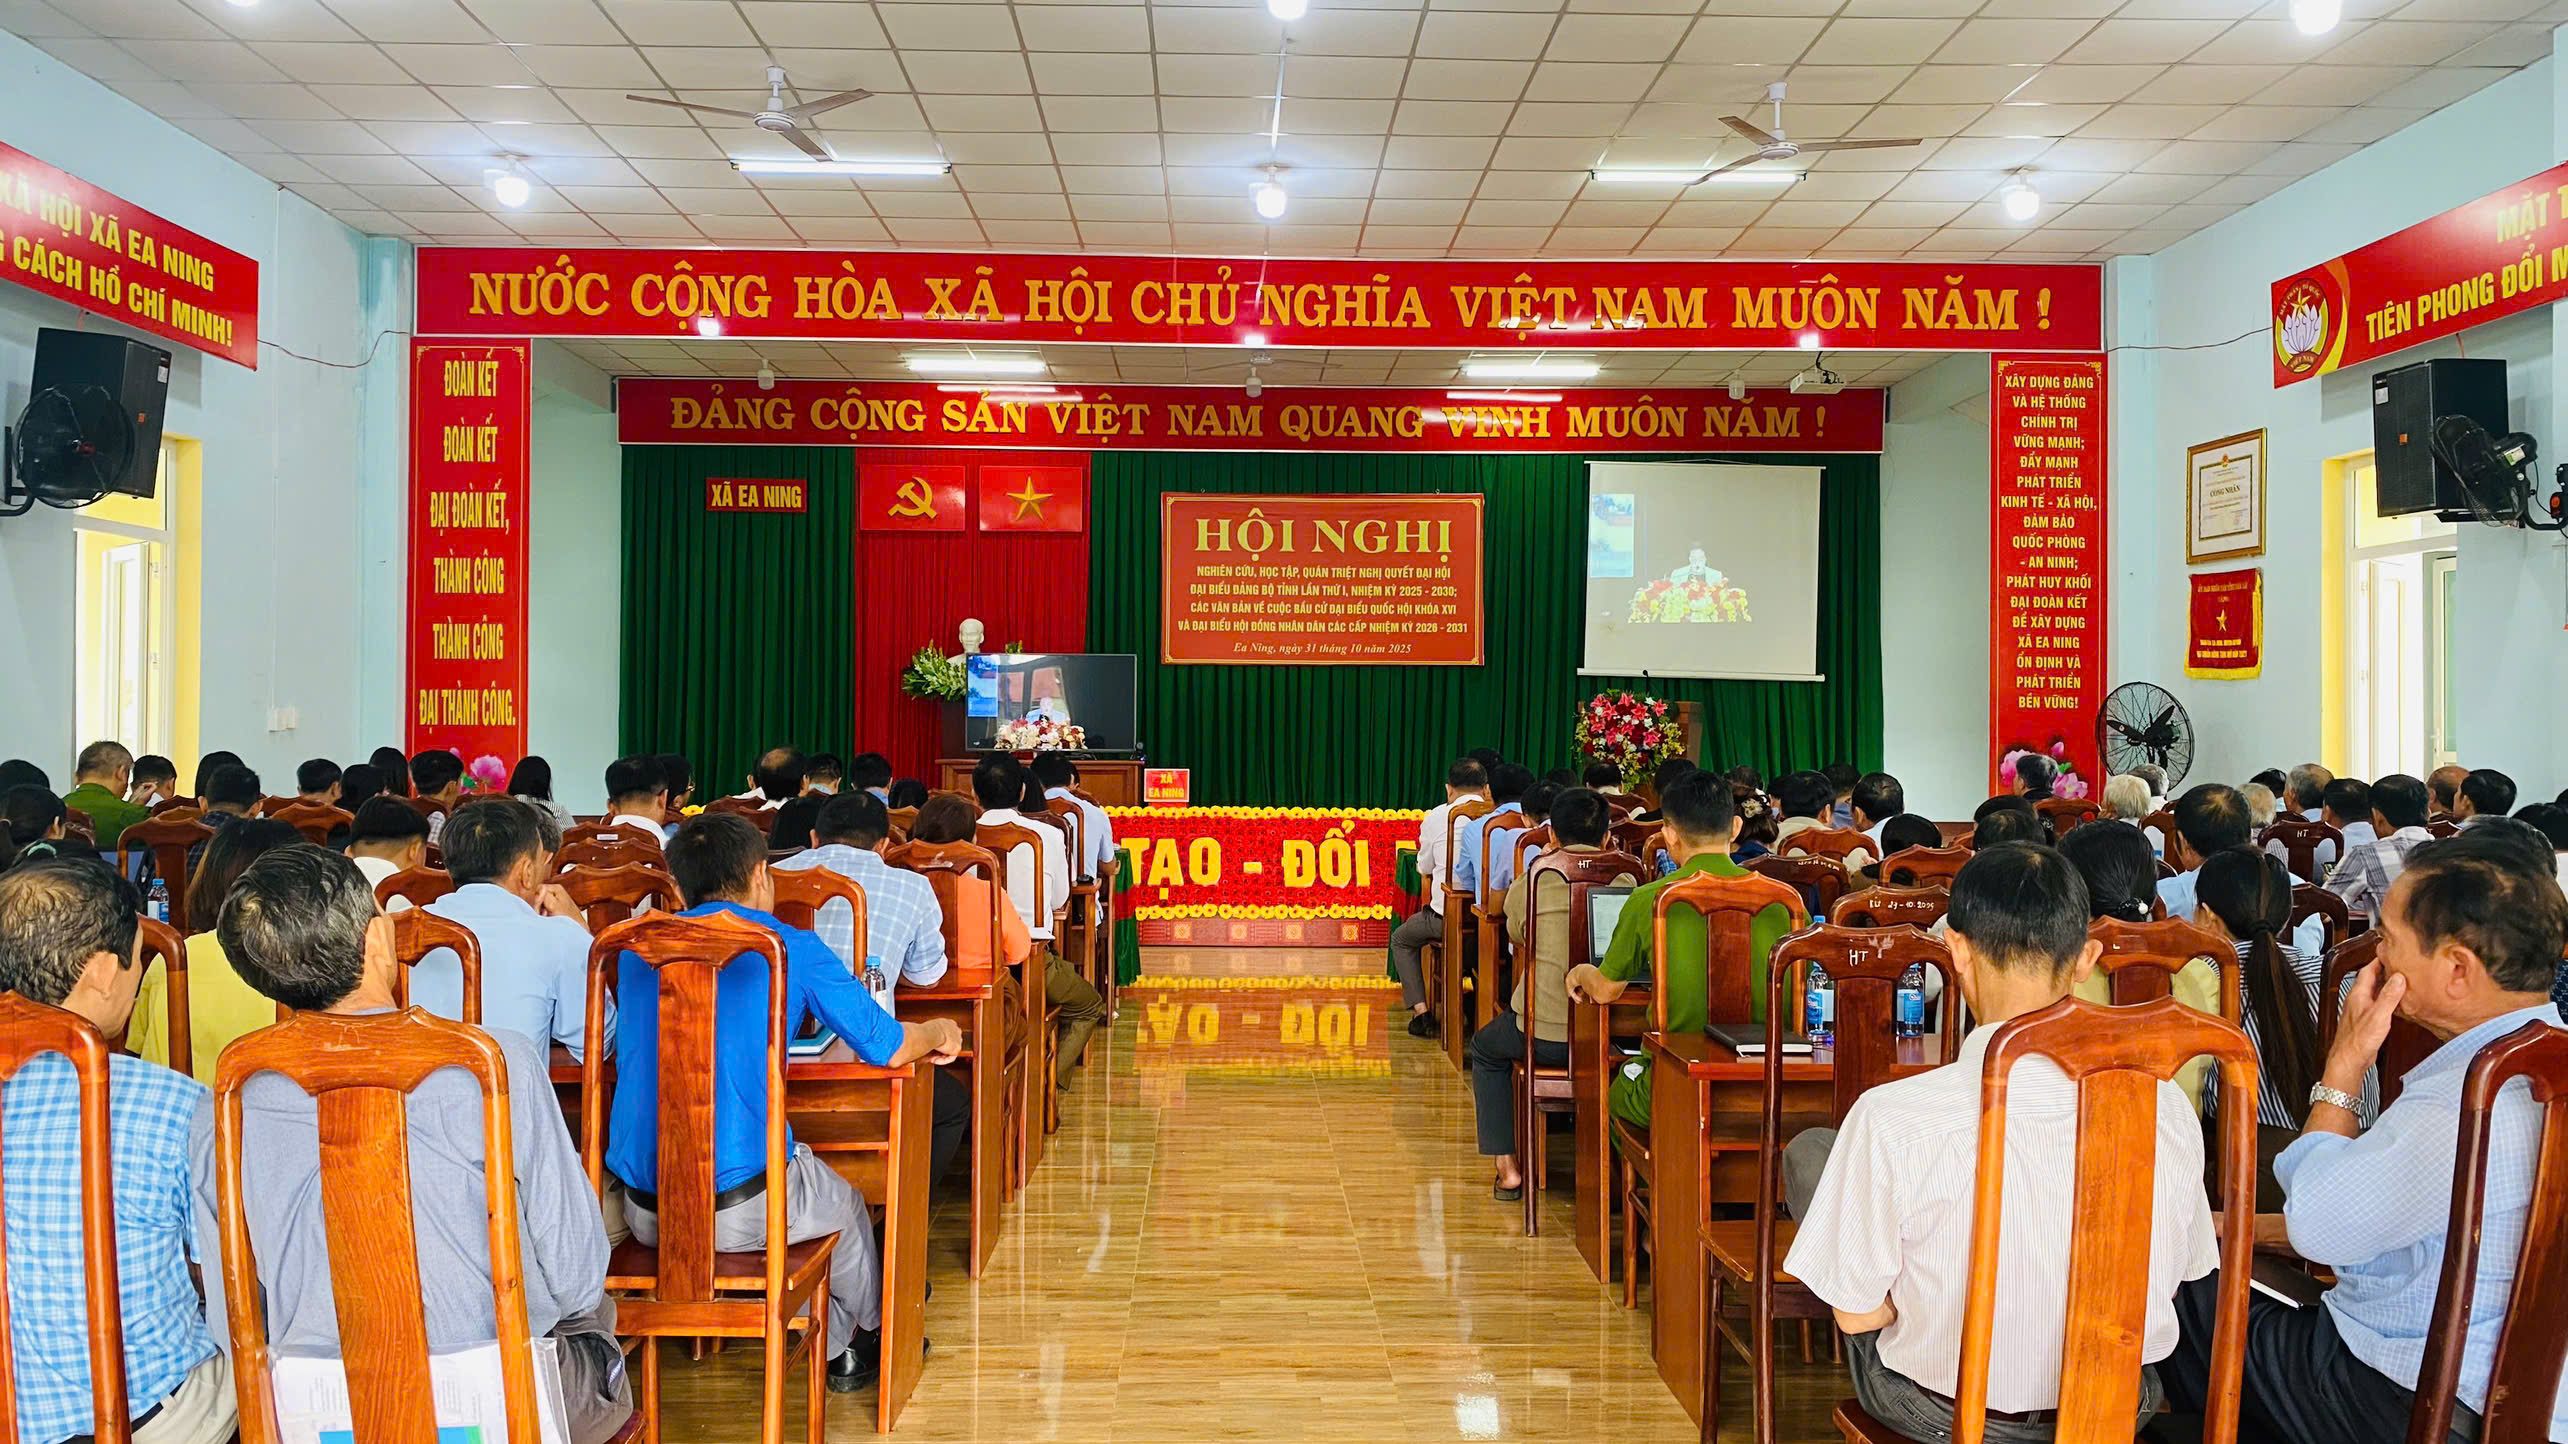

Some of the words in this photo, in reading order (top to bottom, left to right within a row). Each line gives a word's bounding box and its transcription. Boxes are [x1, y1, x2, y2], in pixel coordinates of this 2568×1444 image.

[2497, 192, 2550, 243] MẶT
[40, 192, 81, 238] HỘI
[89, 213, 121, 254] XÃ
[128, 228, 156, 268] EA
[163, 243, 214, 292] NING
[13, 236, 81, 290] CÁCH
[89, 264, 121, 305] HỒ
[128, 282, 165, 323] CHÍ
[171, 298, 232, 347] MINH!
[469, 254, 609, 316] NƯỚC
[631, 260, 772, 330] CỘNG
[793, 260, 903, 320] HÒA
[923, 265, 1004, 322] XÃ
[1024, 266, 1113, 335] HỘI
[1131, 265, 1240, 326] CHỦ
[1259, 273, 1431, 328] NGHĨA
[1450, 272, 1577, 341] VIỆT
[1591, 287, 1708, 329] NAM
[1732, 273, 1880, 329] MUÔN
[1902, 274, 2019, 330] NĂM
[2366, 301, 2411, 343] TIÊN
[2417, 271, 2494, 326] PHONG
[2501, 243, 2543, 299] ĐỔI
[444, 352, 475, 397] ĐOÀN
[478, 347, 499, 397] KẾT
[2005, 373, 2026, 388] XÂY
[2029, 375, 2060, 391] DỰNG
[2063, 374, 2094, 389] ĐẢNG
[2012, 394, 2027, 409] VÀ
[2030, 394, 2045, 411] HỆ
[2049, 393, 2086, 409] THỐNG
[670, 384, 796, 430] ĐẢNG
[810, 387, 926, 440] CỘNG
[941, 388, 1029, 433] SẢN
[1044, 392, 1150, 443] VIỆT
[1166, 404, 1264, 437] NAM
[1279, 404, 1424, 442] QUANG
[1441, 406, 1551, 438] VINH
[1566, 394, 1688, 438] MUÔN
[1703, 396, 1801, 438] NĂM
[2021, 413, 2056, 428] CHÍNH
[2059, 416, 2078, 432] TRỊ
[443, 417, 474, 463] ĐOÀN
[477, 413, 498, 463] KẾT
[2014, 433, 2044, 449] VỮNG
[2047, 436, 2085, 451] MẠNH;
[2045, 456, 2079, 471] MẠNH
[2017, 474, 2046, 489] PHÁT
[2049, 471, 2082, 489] TRIỂN
[711, 481, 734, 507] XÃ
[738, 484, 759, 507] EA
[764, 485, 802, 509] NING
[2001, 495, 2028, 508] KINH
[2031, 492, 2045, 508] TẾ
[2056, 493, 2071, 509] XÃ
[2074, 493, 2097, 511] HỘI,
[430, 491, 450, 536] ĐẠI
[451, 482, 484, 528] ĐOÀN
[485, 478, 510, 535] KẾT,
[2023, 513, 2049, 528] ĐẢM
[2052, 513, 2075, 529] BẢO
[1194, 507, 1296, 562] HỘI
[1311, 518, 1452, 563] NGHỊ
[2012, 532, 2044, 549] QUỐC
[2047, 533, 2086, 549] PHÒNG
[433, 548, 471, 594] THÀNH
[473, 548, 504, 595] CÔNG
[1197, 564, 1232, 577] NGHIÊN
[1235, 565, 1257, 578] CỨU,
[1260, 566, 1278, 579] HỌC
[1303, 565, 1329, 578] QUÁN
[1331, 565, 1357, 580] TRIỆT
[1359, 567, 1382, 580] NGHỊ
[1385, 565, 1414, 578] QUYẾT
[1416, 567, 1432, 580] ĐẠI
[1435, 565, 1451, 580] HỘI
[2028, 556, 2044, 569] AN
[2047, 556, 2079, 570] NINH;
[1209, 580, 1230, 595] BIỂU
[1262, 583, 1274, 597] BỘ
[1351, 584, 1382, 598] NHIỆM
[1400, 585, 1422, 596] 2025
[1431, 586, 1457, 598] 2030;
[2006, 573, 2036, 588] PHÁT
[2039, 576, 2062, 589] HUY
[2065, 573, 2091, 589] KHỐI
[1191, 600, 1208, 613] CÁC
[1267, 601, 1291, 615] CUỘC
[1347, 601, 1368, 615] BIỂU
[1370, 601, 1395, 615] QUỐC
[1397, 603, 1412, 617] HỘI
[1415, 602, 1439, 615] KHÓA
[1442, 605, 1456, 614] XVI
[2010, 596, 2030, 612] ĐẠI
[2033, 594, 2063, 609] ĐOÀN
[2067, 592, 2087, 609] KẾT
[1178, 619, 1190, 631] VÀ
[1210, 617, 1231, 631] BIỂU
[1233, 619, 1248, 633] HỘI
[1278, 620, 1304, 632] NHÂN
[1370, 621, 1399, 635] NHIỆM
[1416, 623, 1438, 632] 2026
[1447, 623, 1467, 632] 2031
[2012, 611, 2027, 628] ĐỂ
[2030, 613, 2052, 628] XÂY
[2055, 615, 2086, 632] DỰNG
[432, 616, 470, 660] THÀNH
[472, 614, 504, 660] CÔNG
[2018, 634, 2032, 648] XÃ
[2036, 636, 2049, 648] EA
[2053, 636, 2080, 648] NING
[1234, 643, 1247, 652] Ea
[1250, 643, 1276, 654] Ning,
[1279, 643, 1302, 655] ngày
[1305, 644, 1316, 653] 31
[1320, 644, 1347, 655] tháng
[1351, 644, 1361, 653] 10
[1364, 644, 1385, 653] năm
[1388, 644, 1411, 653] 2025
[2035, 656, 2063, 671] ĐỊNH
[2066, 654, 2081, 669] VÀ
[2016, 674, 2046, 689] PHÁT
[2048, 671, 2081, 689] TRIỂN
[419, 689, 439, 734] ĐẠI
[441, 681, 480, 726] THÀNH
[481, 681, 516, 726] CÔNG.
[2044, 693, 2079, 709] VỮNG!
[1149, 788, 1160, 798] EA
[1162, 787, 1184, 798] NING
[2297, 829, 2309, 838] HT
[1121, 837, 1222, 900] TẠO
[1281, 820, 1370, 888] ĐỔI
[1578, 860, 1592, 869] HT
[1849, 949, 1868, 966] HT
